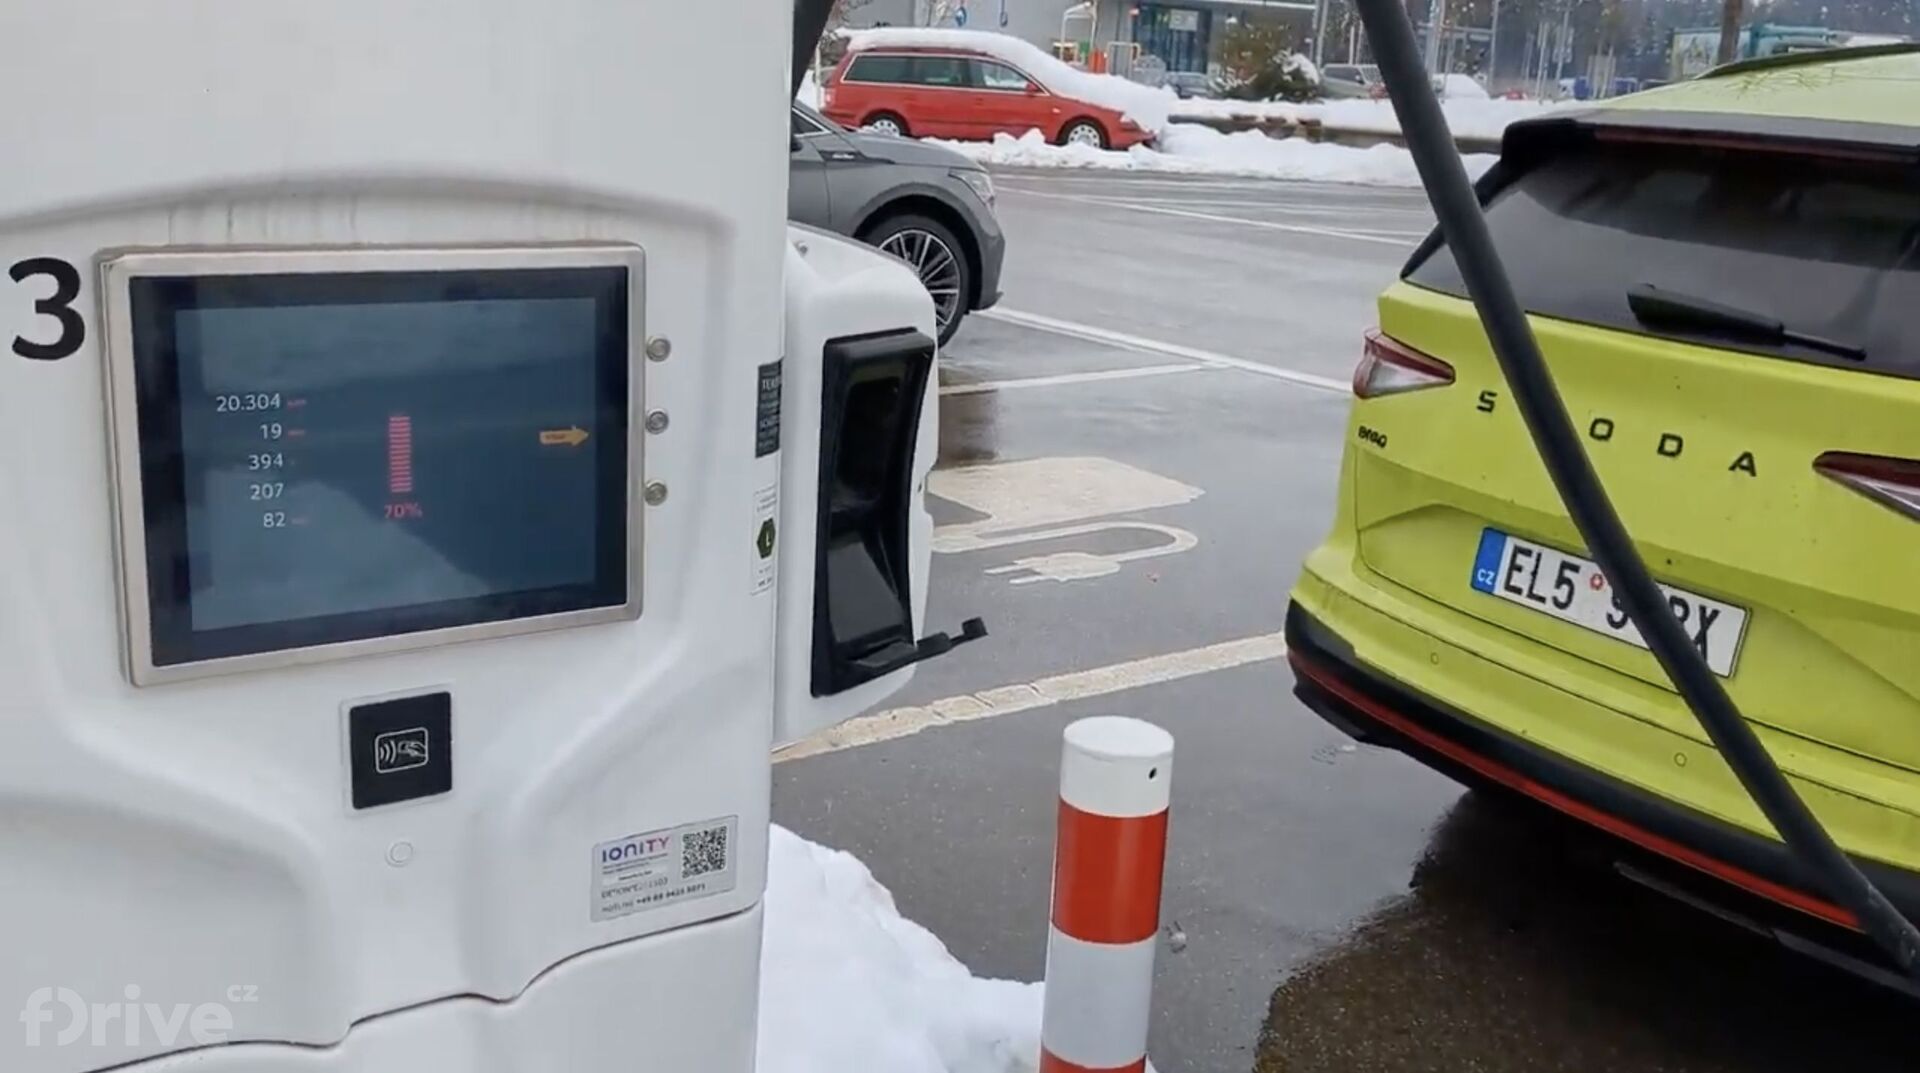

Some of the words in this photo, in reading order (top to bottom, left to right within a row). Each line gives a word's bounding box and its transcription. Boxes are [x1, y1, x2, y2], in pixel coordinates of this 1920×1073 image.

[8, 257, 85, 361] 3
[216, 393, 280, 412] 20.304
[260, 423, 282, 439] 19
[1476, 389, 1757, 478] SODA
[248, 453, 283, 470] 394
[250, 483, 283, 500] 207
[384, 502, 422, 518] 70%
[263, 512, 285, 528] 82
[1477, 568, 1495, 585] CZ
[1504, 544, 1581, 611] EL5
